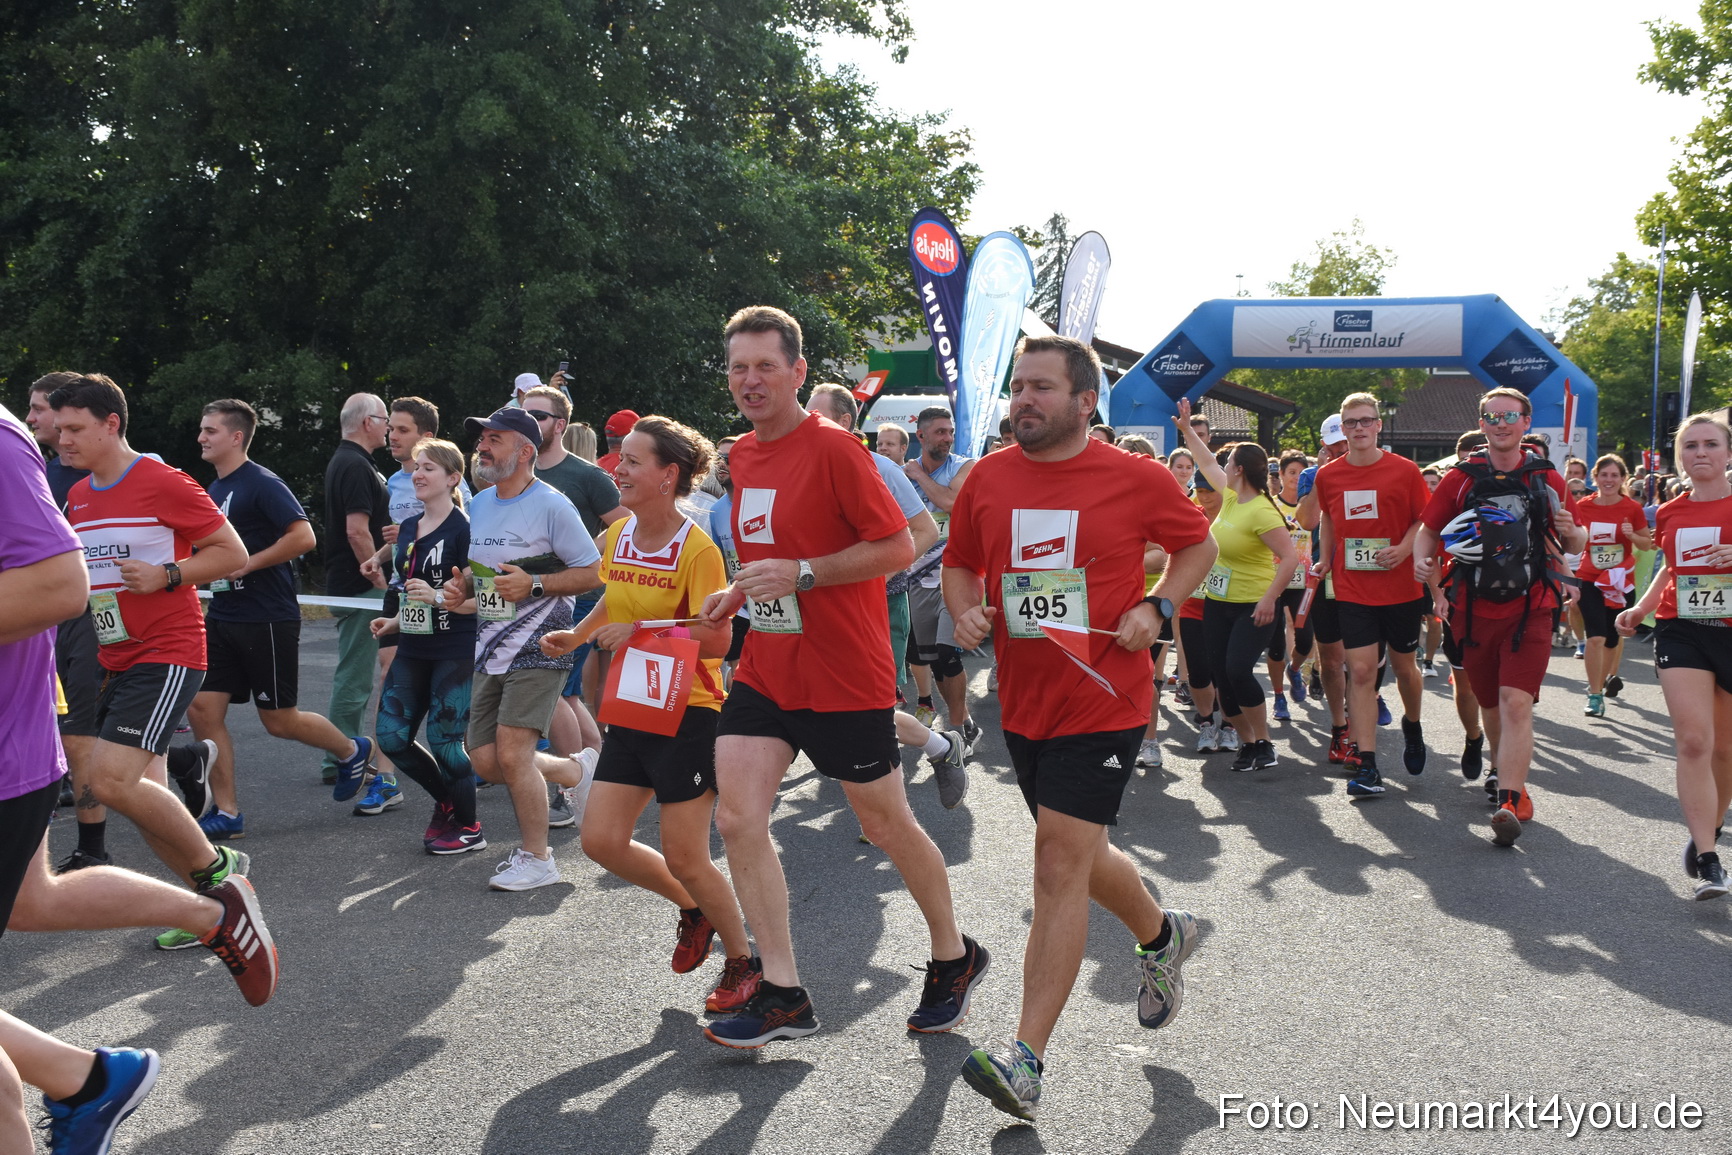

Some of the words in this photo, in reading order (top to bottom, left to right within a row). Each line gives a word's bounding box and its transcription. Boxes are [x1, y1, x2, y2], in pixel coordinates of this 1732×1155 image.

[1320, 332, 1405, 348] firmenlauf
[1160, 361, 1204, 371] Fischer
[1033, 543, 1053, 555] DEHN
[728, 560, 742, 571] 193
[1597, 553, 1617, 563] 527
[608, 569, 636, 584] MAX
[637, 572, 677, 590] BÖGL
[477, 592, 506, 609] 1941
[1688, 590, 1725, 606] 474
[401, 607, 426, 623] 1928
[1018, 594, 1068, 620] 495
[649, 669, 658, 689] DEHN
[666, 690, 679, 712] DEHN
[673, 659, 685, 690] protects.
[116, 725, 142, 736] adidas
